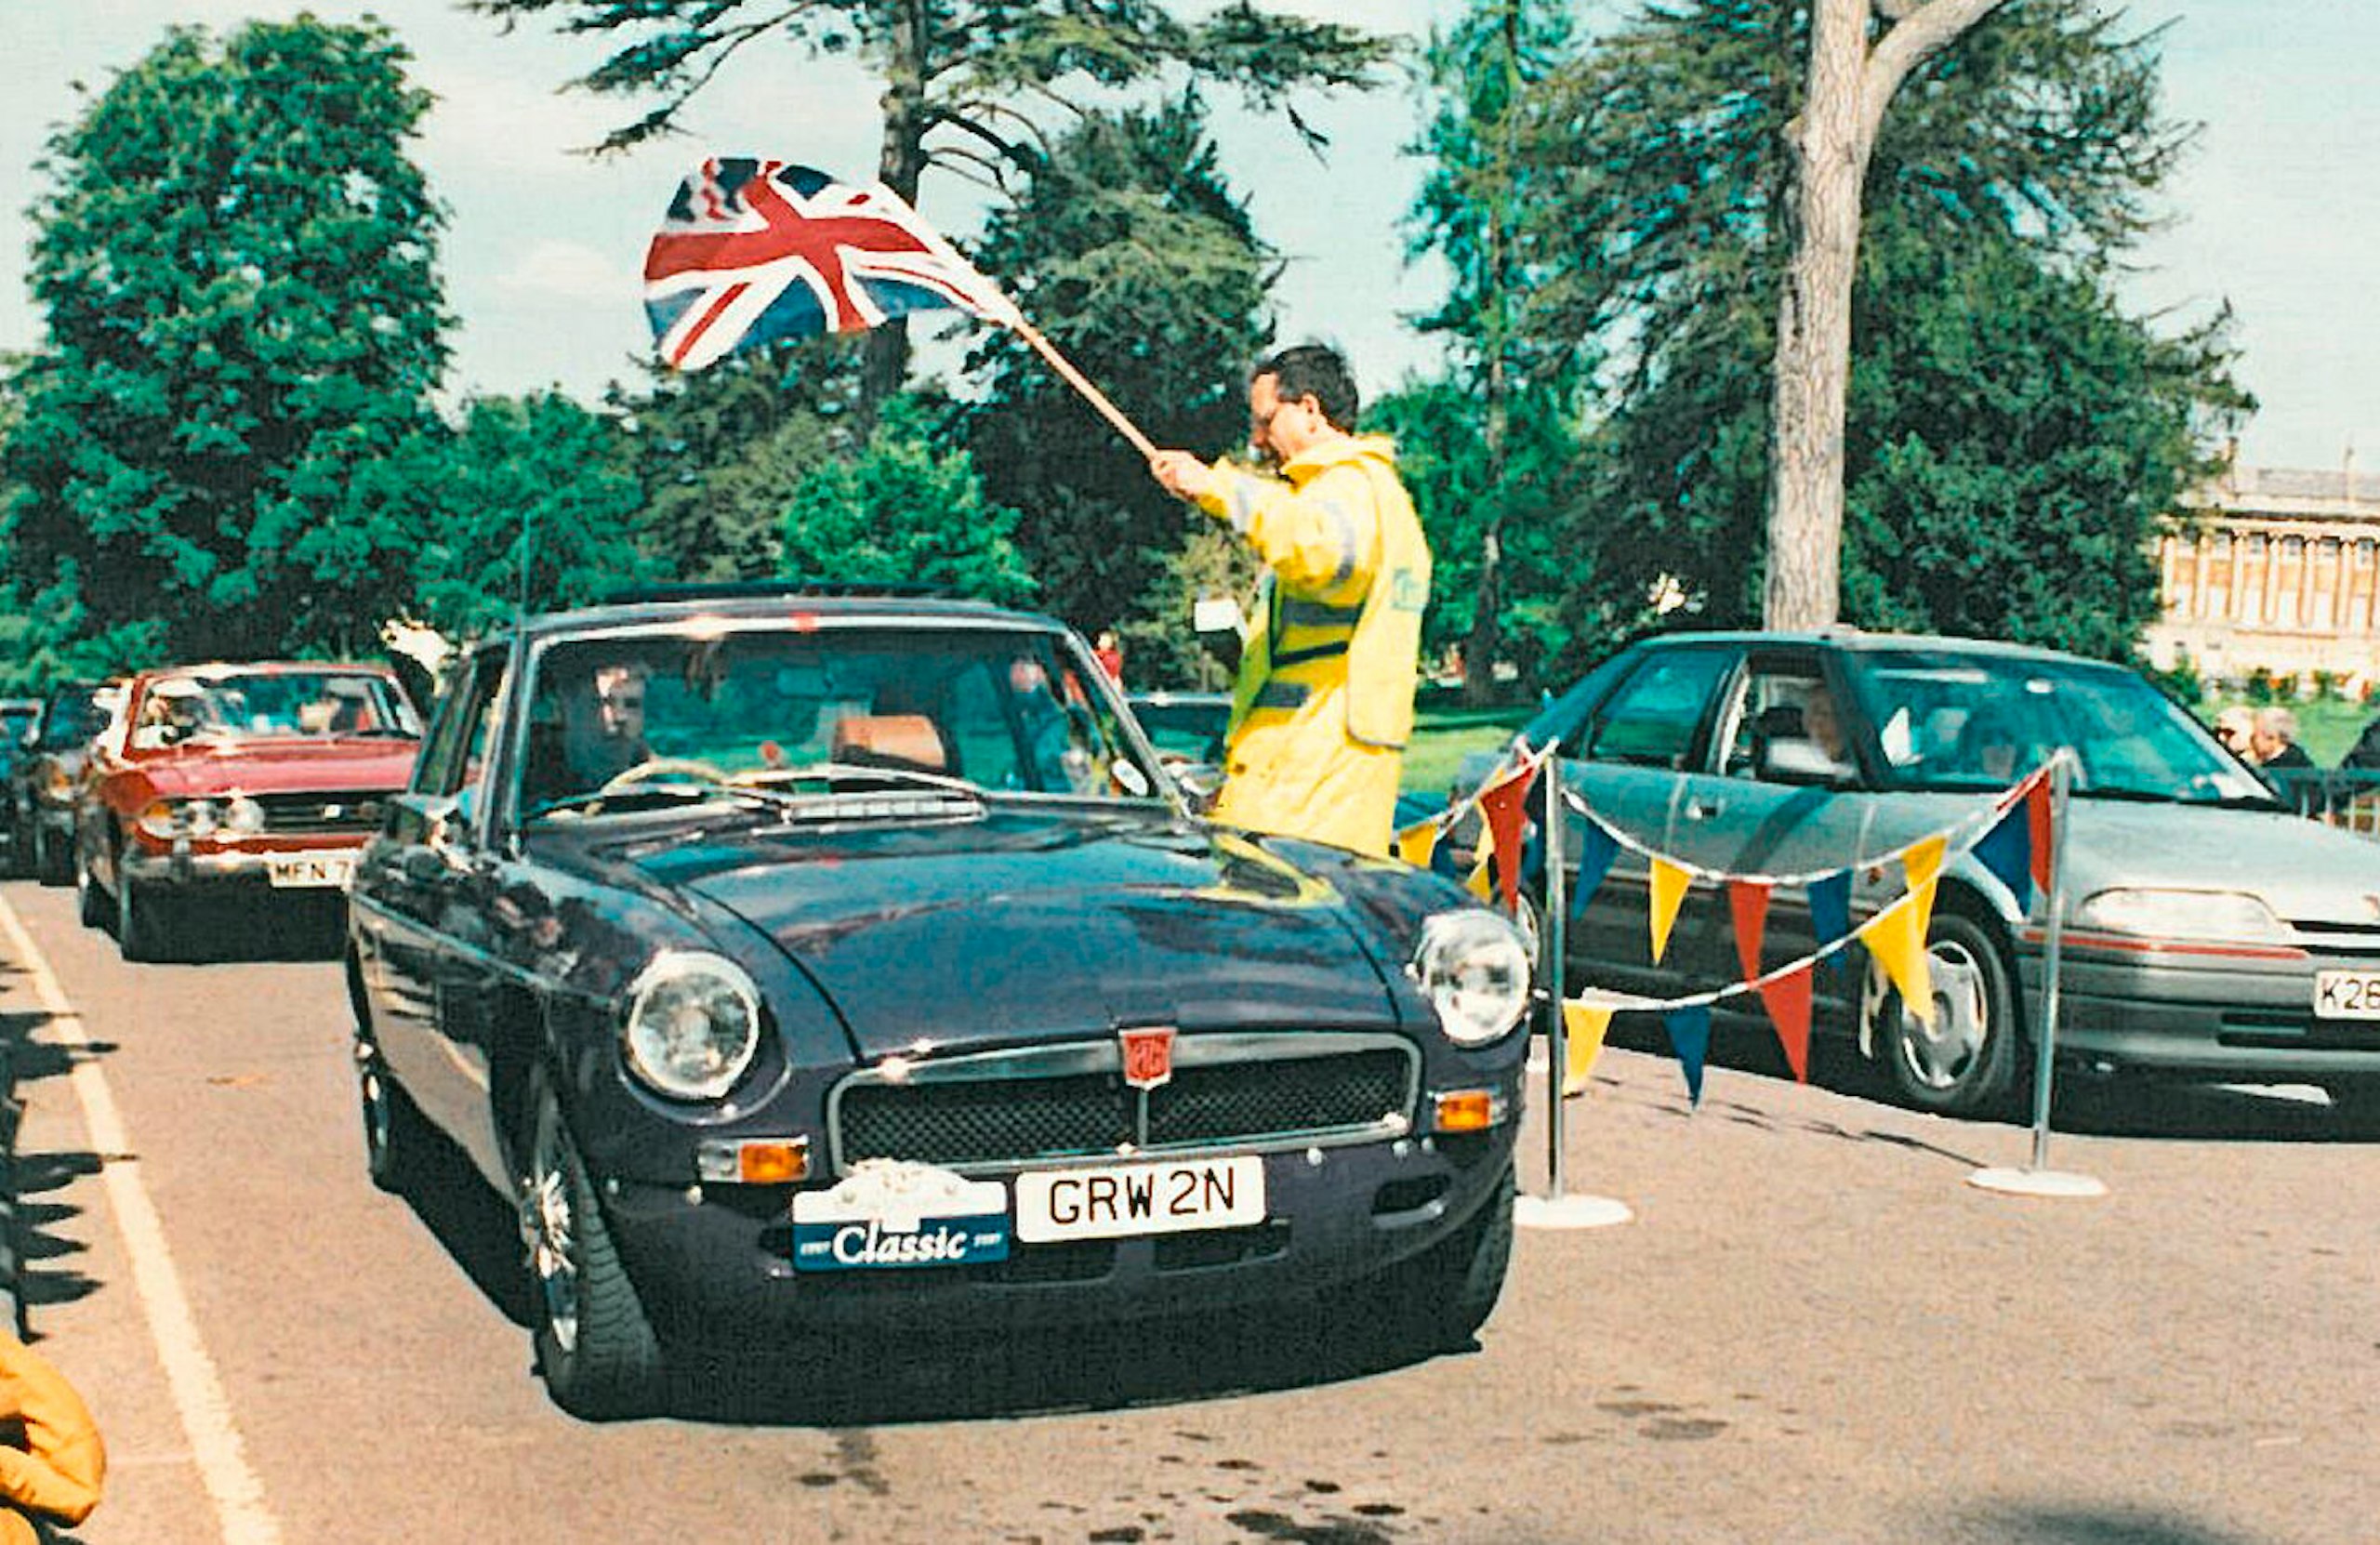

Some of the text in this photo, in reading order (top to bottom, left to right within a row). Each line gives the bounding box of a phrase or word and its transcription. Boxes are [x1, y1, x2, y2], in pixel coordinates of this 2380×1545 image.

[1050, 1166, 1235, 1225] GRW 2N
[833, 1219, 968, 1264] Classic
